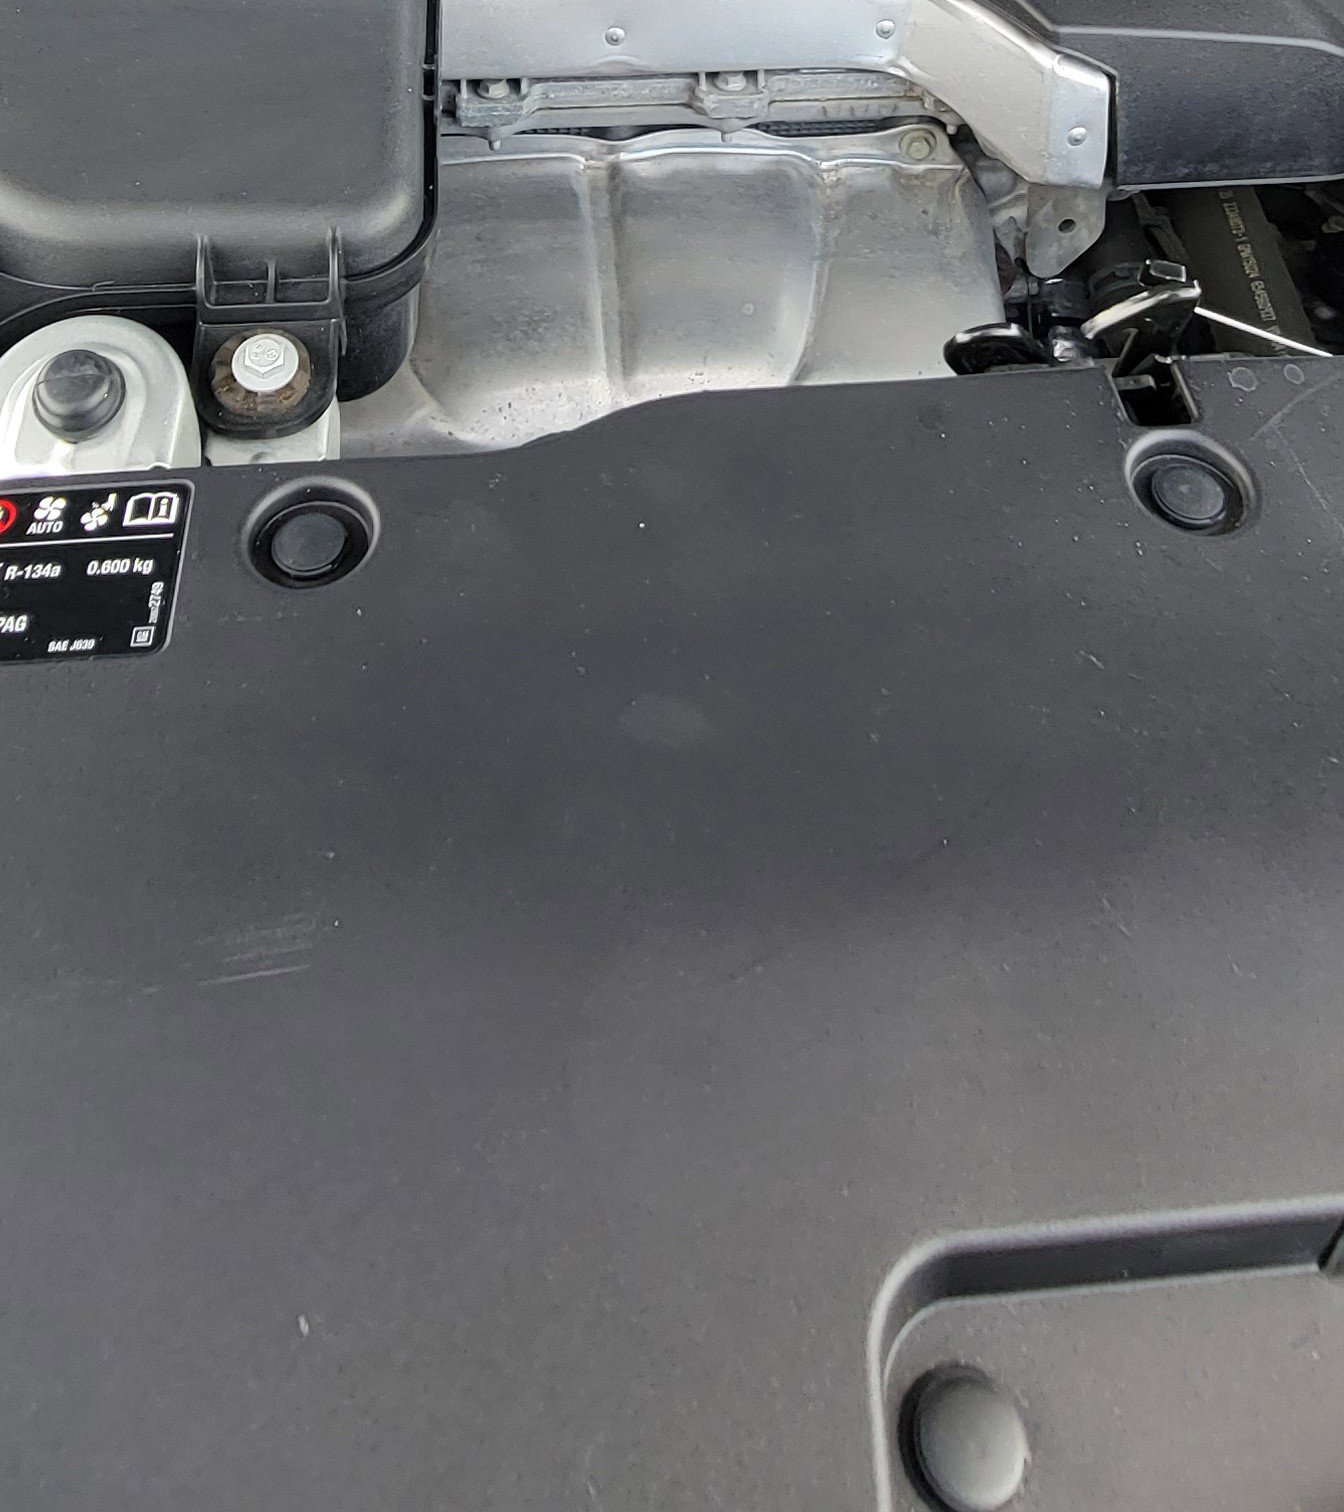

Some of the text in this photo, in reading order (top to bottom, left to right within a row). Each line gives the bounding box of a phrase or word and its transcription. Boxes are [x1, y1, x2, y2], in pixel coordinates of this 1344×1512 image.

[26, 520, 63, 535] AUTO
[4, 563, 62, 581] R-134a
[132, 557, 154, 575] kg
[136, 630, 149, 642] GM
